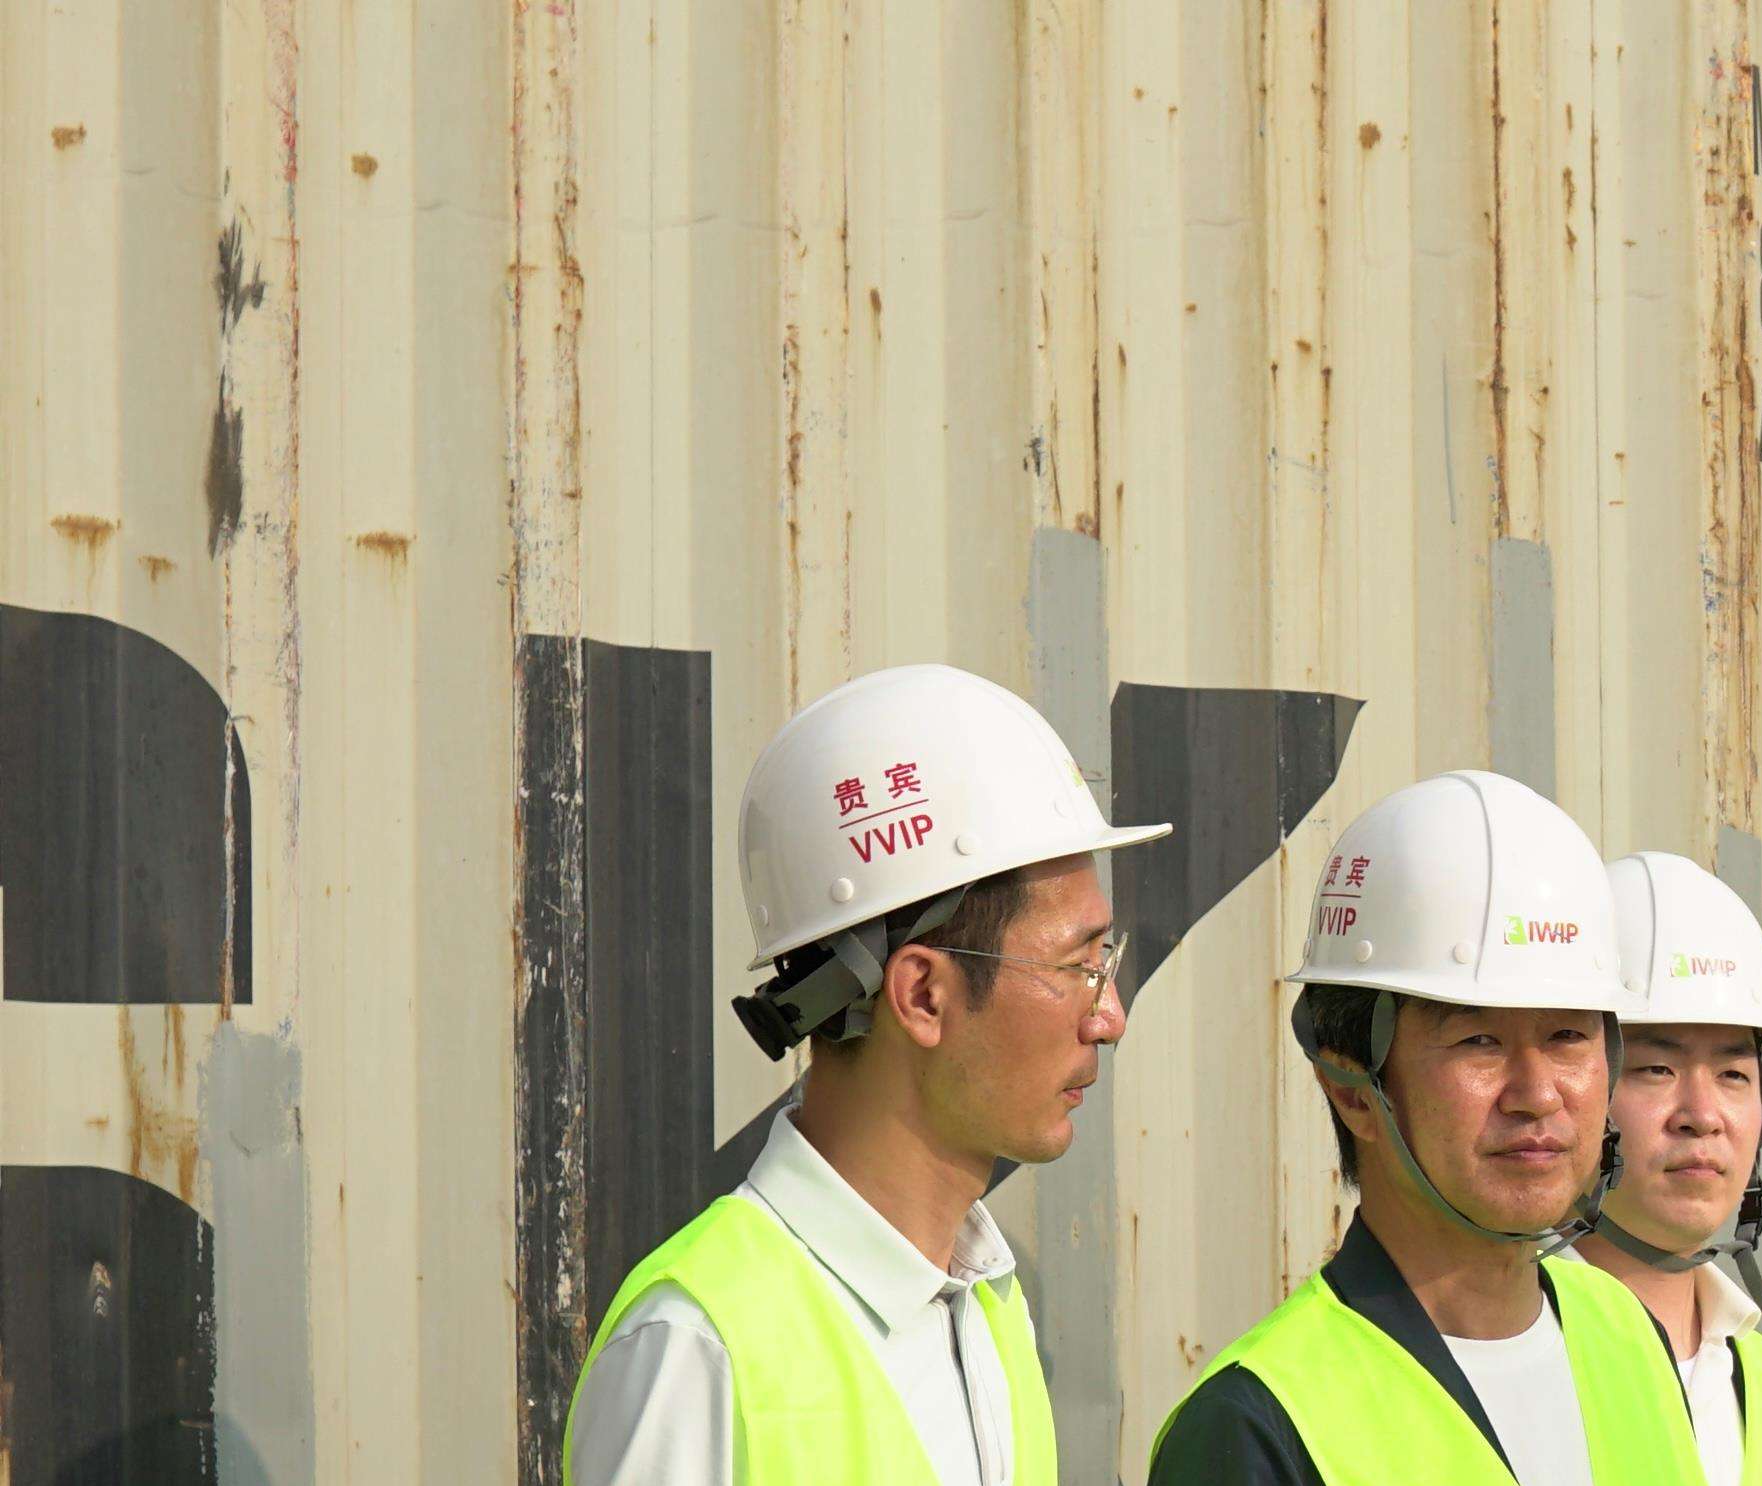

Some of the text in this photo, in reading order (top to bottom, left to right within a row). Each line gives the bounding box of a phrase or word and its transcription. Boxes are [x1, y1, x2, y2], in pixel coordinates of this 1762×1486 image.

[834, 763, 921, 816] 贵宾
[848, 814, 933, 863] VVIP
[1324, 855, 1371, 888] 贵宾
[1318, 905, 1357, 936] VVIP
[1528, 921, 1579, 944] IWIP
[1691, 956, 1736, 977] IWIP
